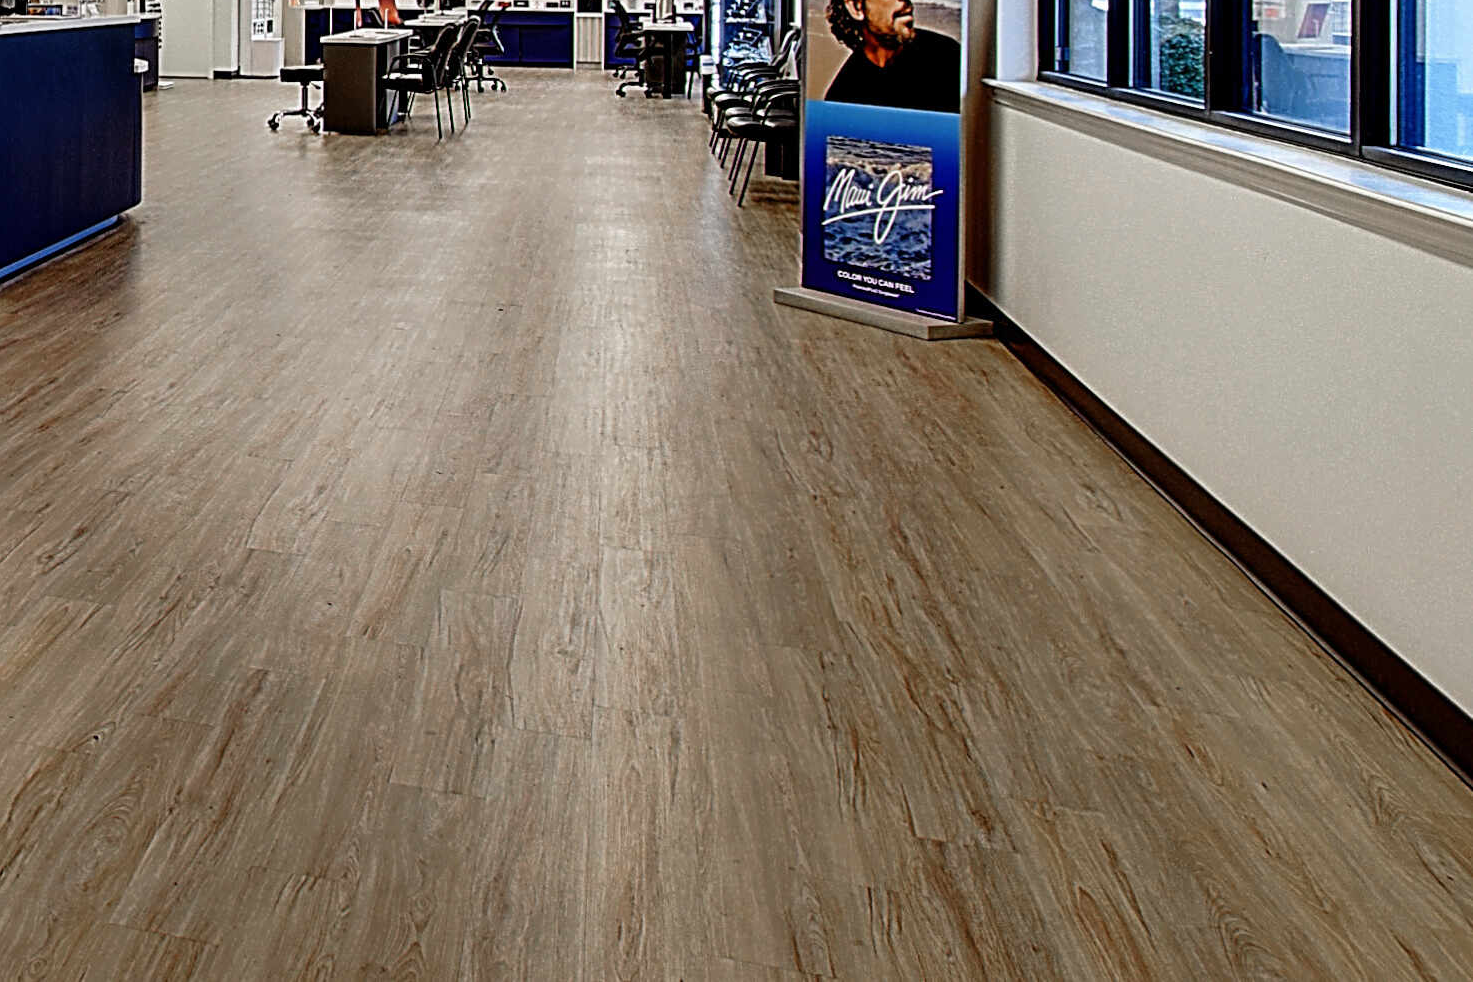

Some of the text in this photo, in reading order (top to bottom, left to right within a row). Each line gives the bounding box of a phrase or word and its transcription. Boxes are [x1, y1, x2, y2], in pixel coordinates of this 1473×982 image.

[822, 168, 944, 245] Maui Jim
[837, 270, 862, 281] COLOR
[863, 276, 878, 285] YOU
[878, 279, 894, 289] CAN
[895, 283, 915, 294] FEEL
